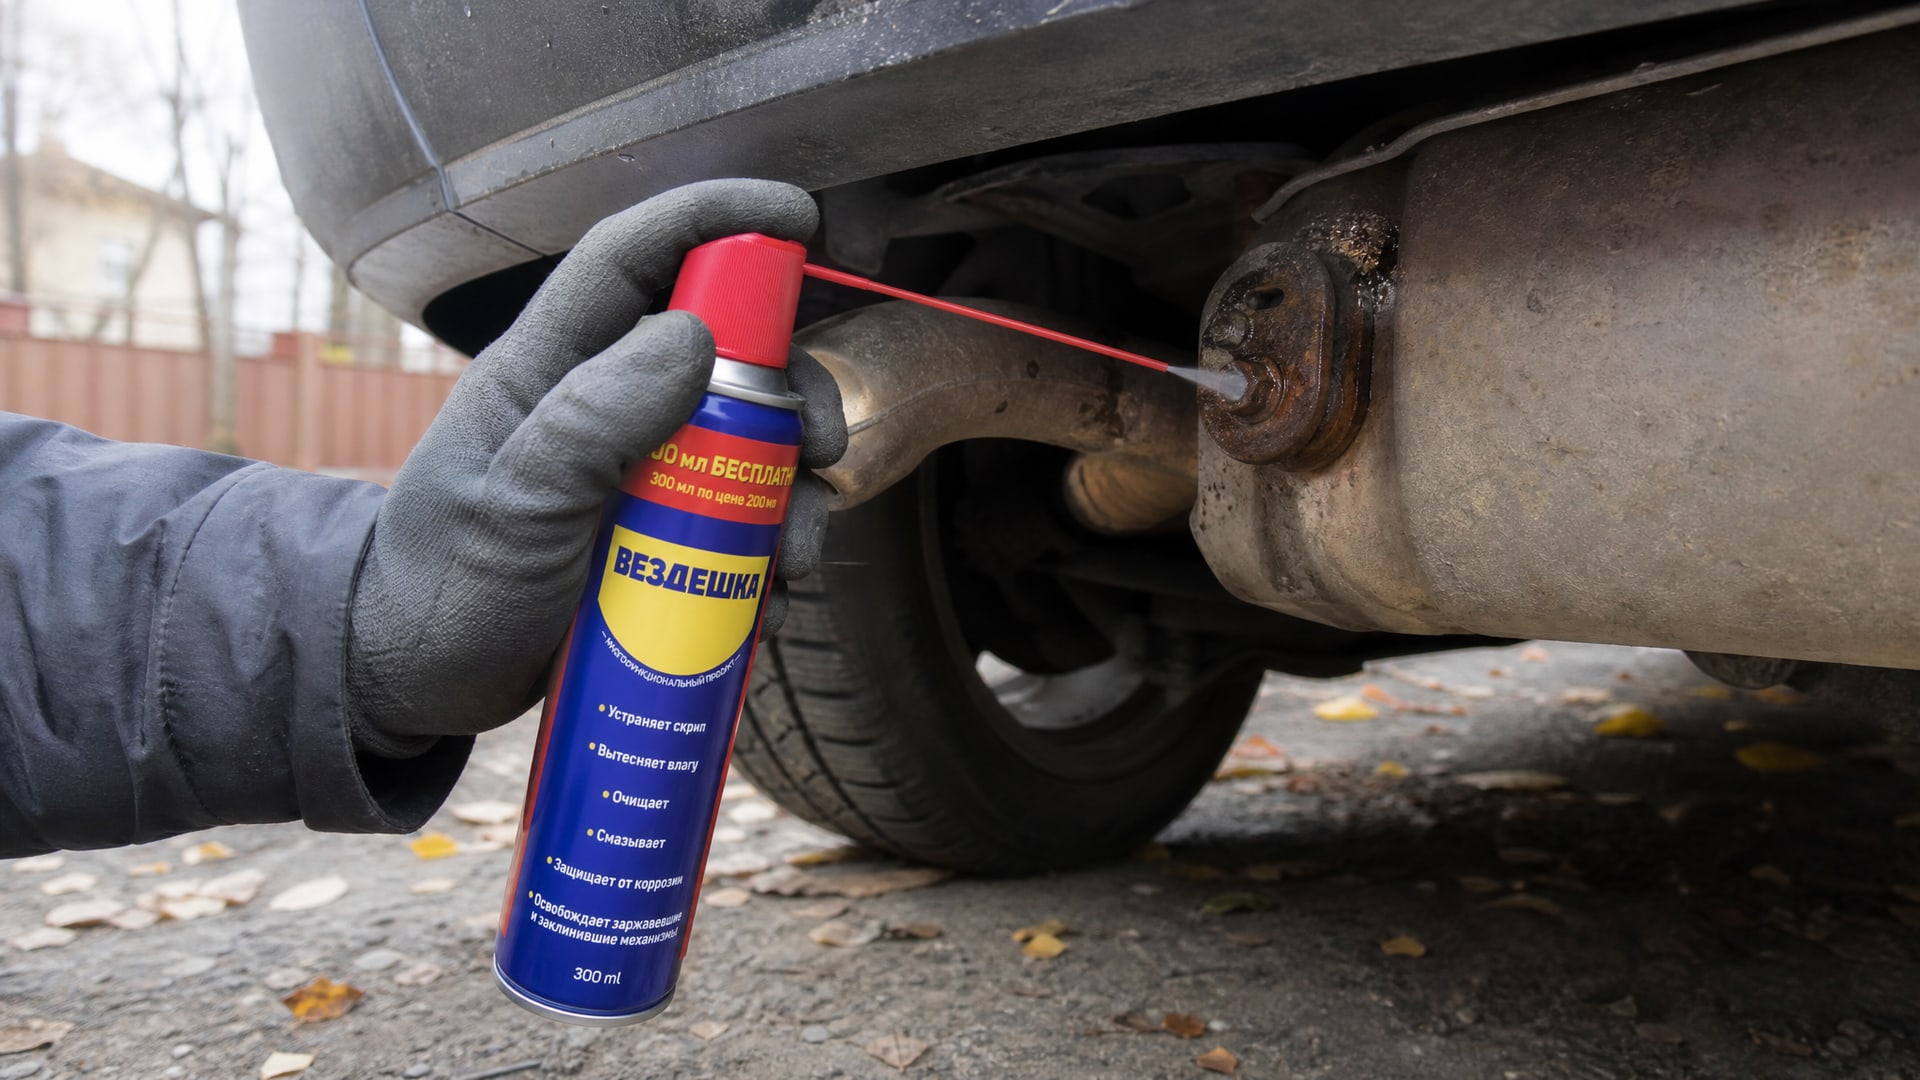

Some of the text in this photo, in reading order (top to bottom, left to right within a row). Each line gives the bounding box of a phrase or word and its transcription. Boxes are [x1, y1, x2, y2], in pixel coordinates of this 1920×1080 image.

[680, 453, 708, 473] мл
[650, 471, 676, 490] 300
[676, 481, 695, 496] мл
[697, 487, 713, 499] по
[715, 491, 745, 506] цене
[614, 545, 760, 600] ВЕЗДЕШКА
[608, 704, 706, 735] Устраняет скрип
[597, 743, 699, 773] Вытесняет влагу
[612, 790, 669, 810] Очищает
[597, 829, 666, 849] Смазывает
[553, 857, 684, 892] Защищает от коррозии
[534, 893, 683, 932] Освобождает заржавевшие
[530, 911, 679, 946] и заклинившие механизмы
[573, 967, 622, 985] 300 ml
